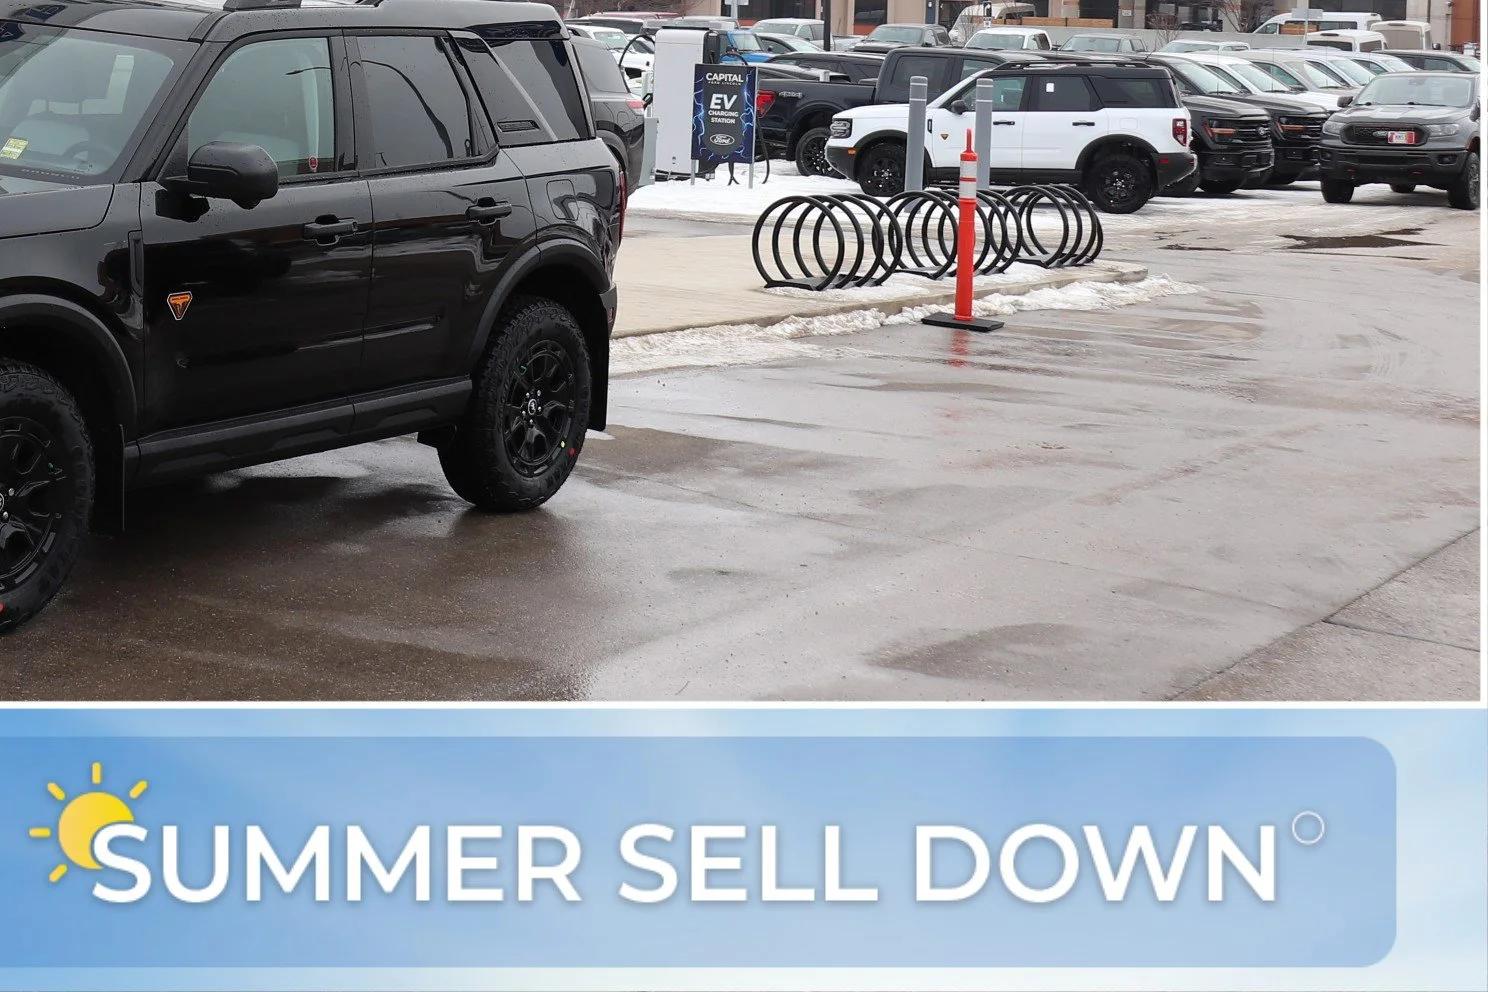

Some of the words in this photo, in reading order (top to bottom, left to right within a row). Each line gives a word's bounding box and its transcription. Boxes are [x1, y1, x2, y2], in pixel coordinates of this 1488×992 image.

[705, 72, 744, 82] CAPITAL
[709, 93, 738, 110] EV
[708, 109, 739, 118] CHARGING
[710, 117, 736, 125] STATION
